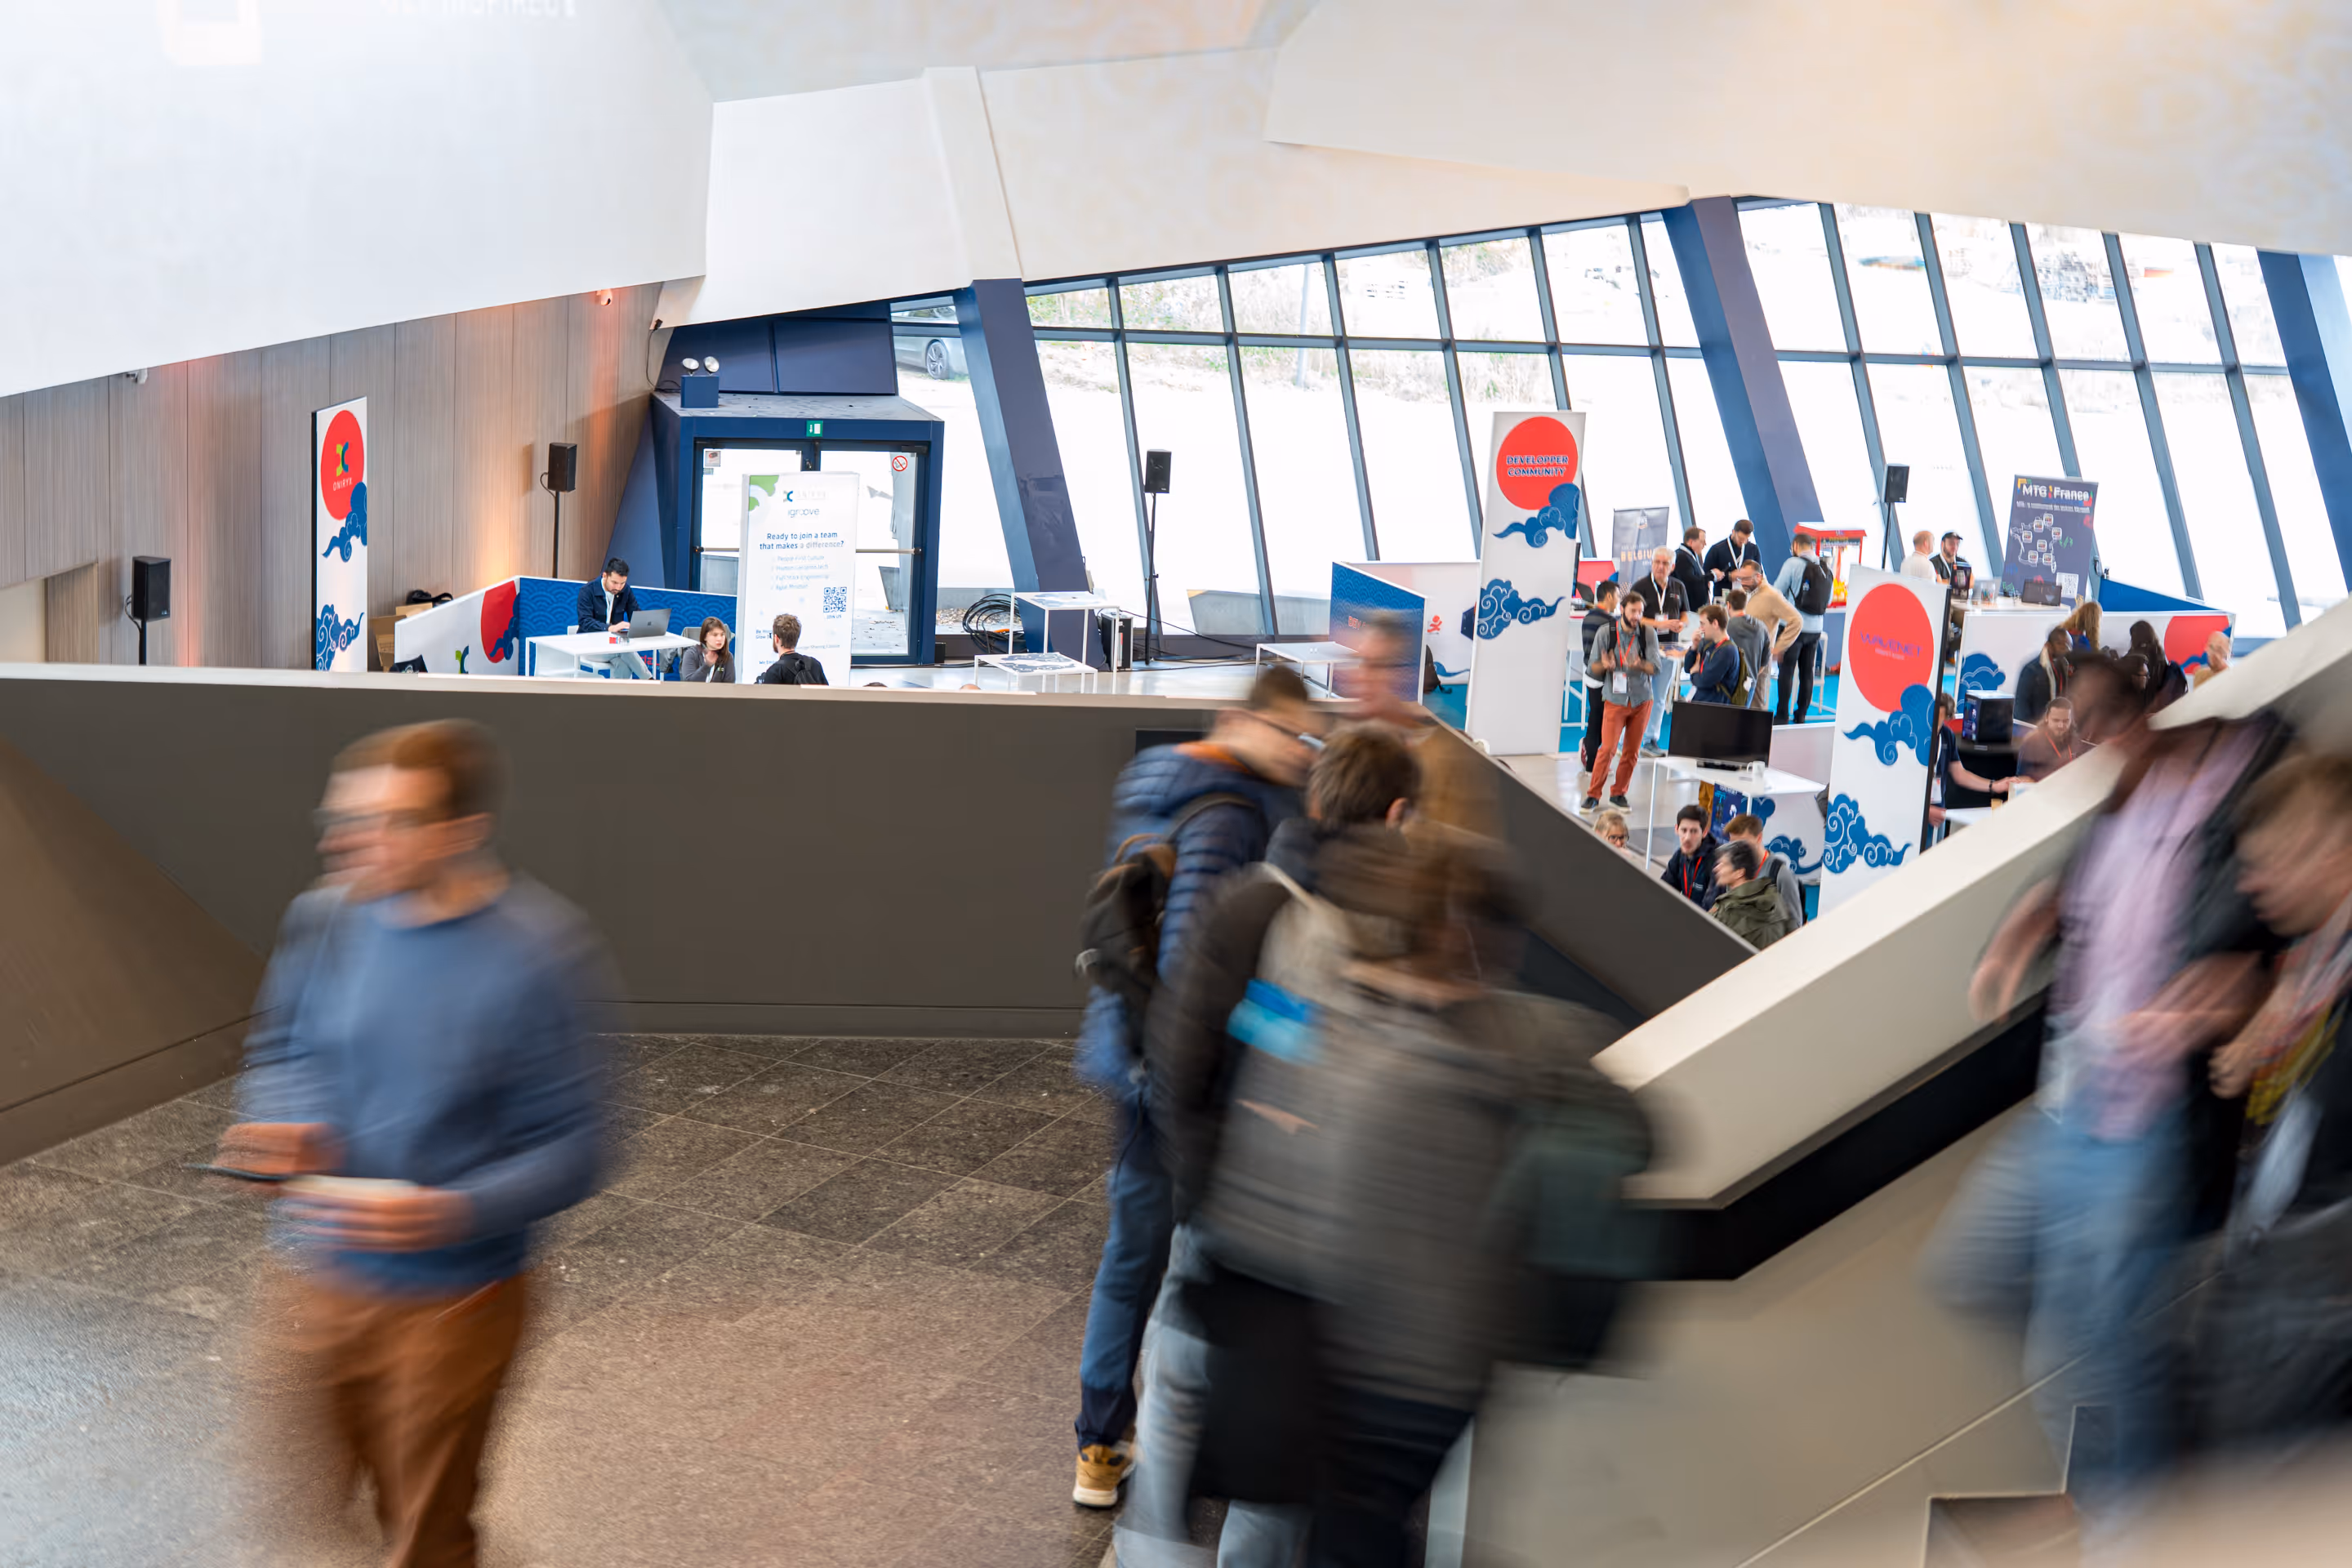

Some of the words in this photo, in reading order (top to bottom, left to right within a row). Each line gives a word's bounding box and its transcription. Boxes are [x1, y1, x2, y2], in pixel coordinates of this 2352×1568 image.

[1506, 455, 1569, 465] DEVELOPPER
[1508, 466, 1566, 477] COMMUNITY
[332, 477, 353, 492] ONIRYX
[767, 532, 789, 541] Ready
[805, 541, 844, 549] difference?
[1621, 549, 1652, 562] BELGIU
